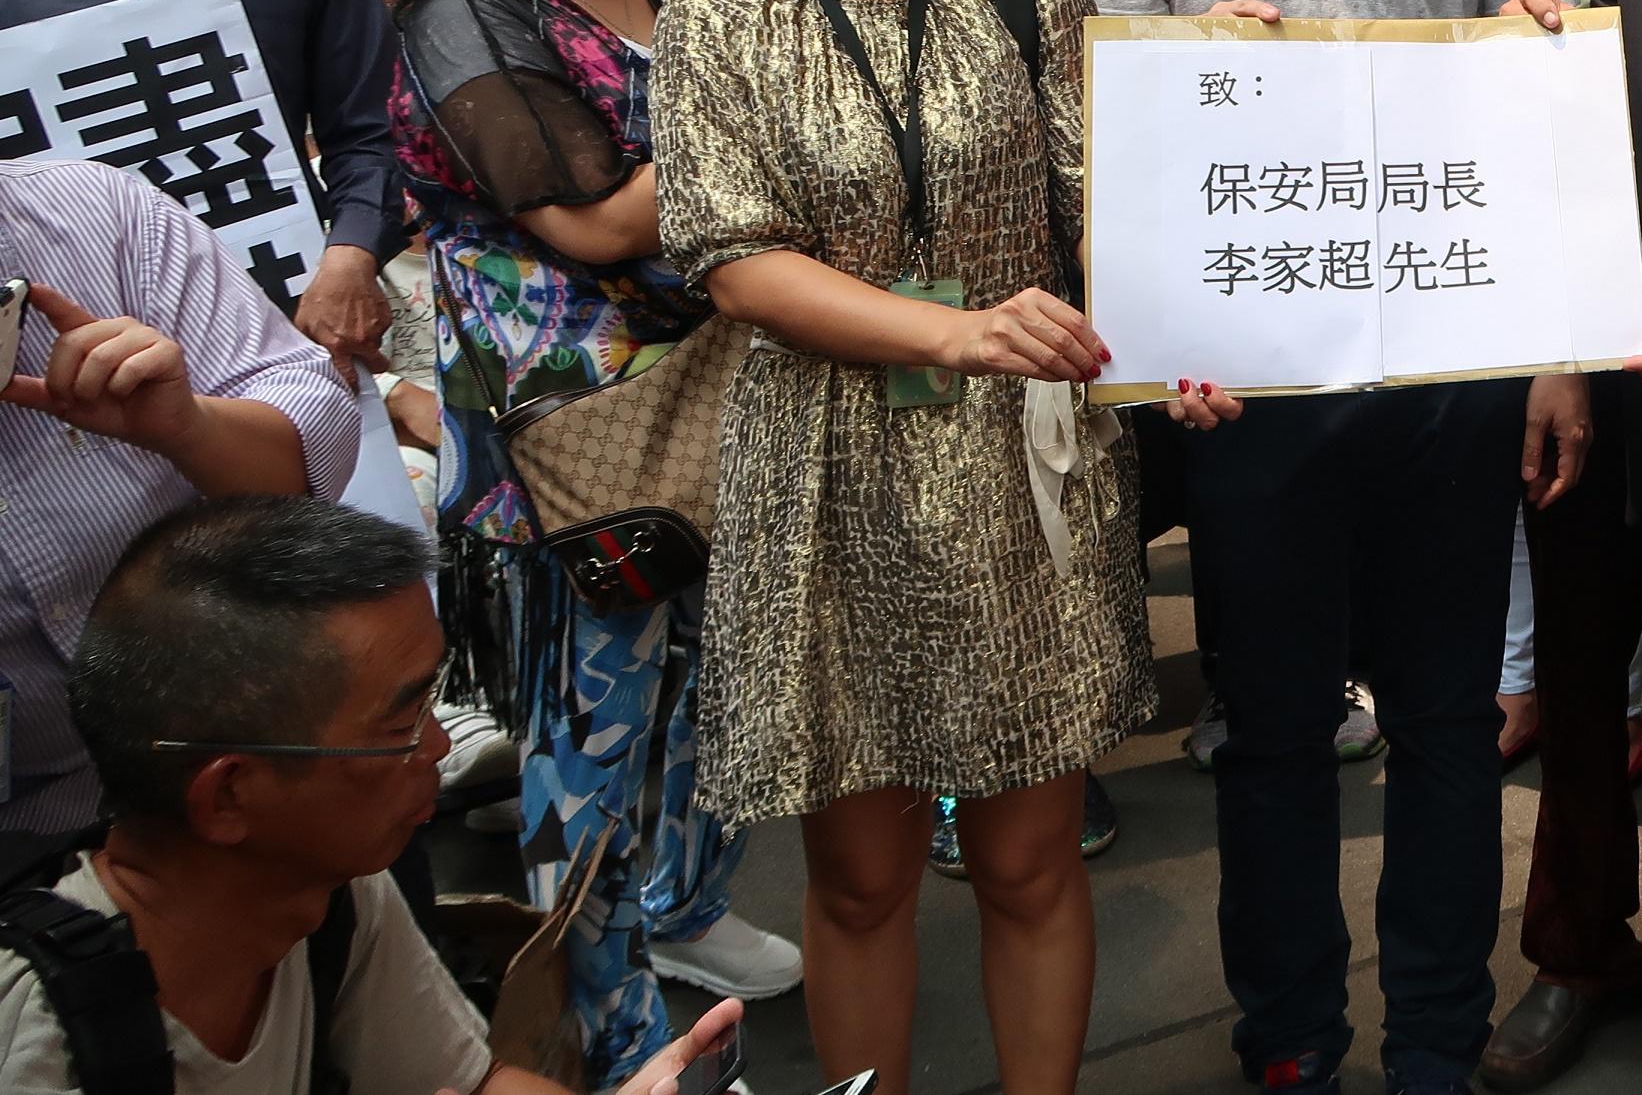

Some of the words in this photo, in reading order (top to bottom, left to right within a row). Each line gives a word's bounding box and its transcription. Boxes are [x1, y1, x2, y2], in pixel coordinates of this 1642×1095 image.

[0, 30, 299, 231] 盡
[1200, 159, 1487, 215] 保安局局長
[1202, 238, 1497, 295] 李家超先生
